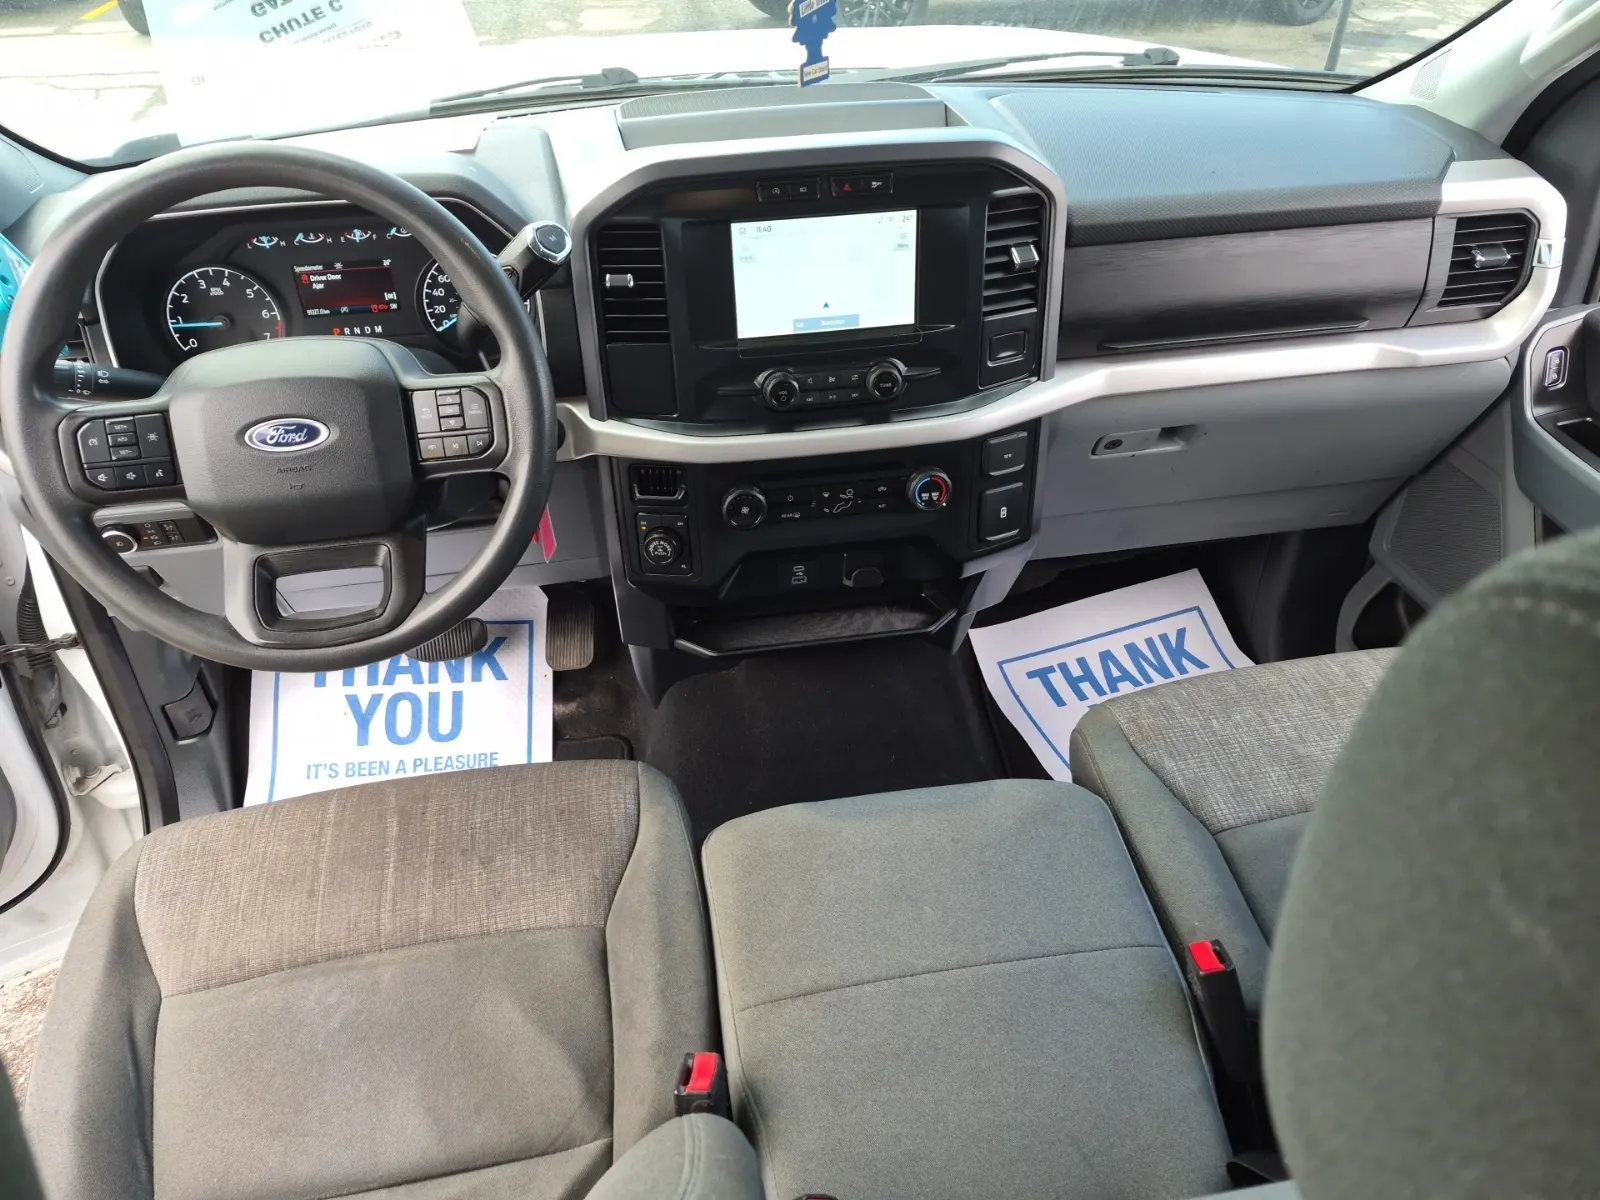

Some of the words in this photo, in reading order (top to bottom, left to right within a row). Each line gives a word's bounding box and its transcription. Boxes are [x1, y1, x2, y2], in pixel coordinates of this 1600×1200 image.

[310, 274, 327, 282] Driver
[327, 273, 342, 281] Door
[437, 274, 451, 283] 60
[198, 279, 207, 289] 3
[222, 278, 231, 288] 4
[312, 282, 325, 290] Ajar
[246, 289, 255, 298] 5
[432, 288, 445, 297] 40
[180, 294, 190, 303] 2
[261, 309, 270, 318] 6
[433, 305, 446, 314] 20
[332, 328, 341, 337] P
[344, 327, 351, 336] R
[353, 326, 361, 335] N
[364, 325, 372, 334] D
[374, 325, 383, 333] M
[263, 333, 271, 341] 7
[189, 338, 198, 348] 0
[266, 425, 308, 445] Ford
[276, 465, 312, 474] AIRBAG
[1025, 627, 1210, 707] THANK
[344, 690, 464, 746] YOU
[306, 763, 339, 779] IT'S
[345, 760, 390, 777] BEEN
[395, 759, 407, 774] A
[412, 752, 499, 773] PLEASURE
